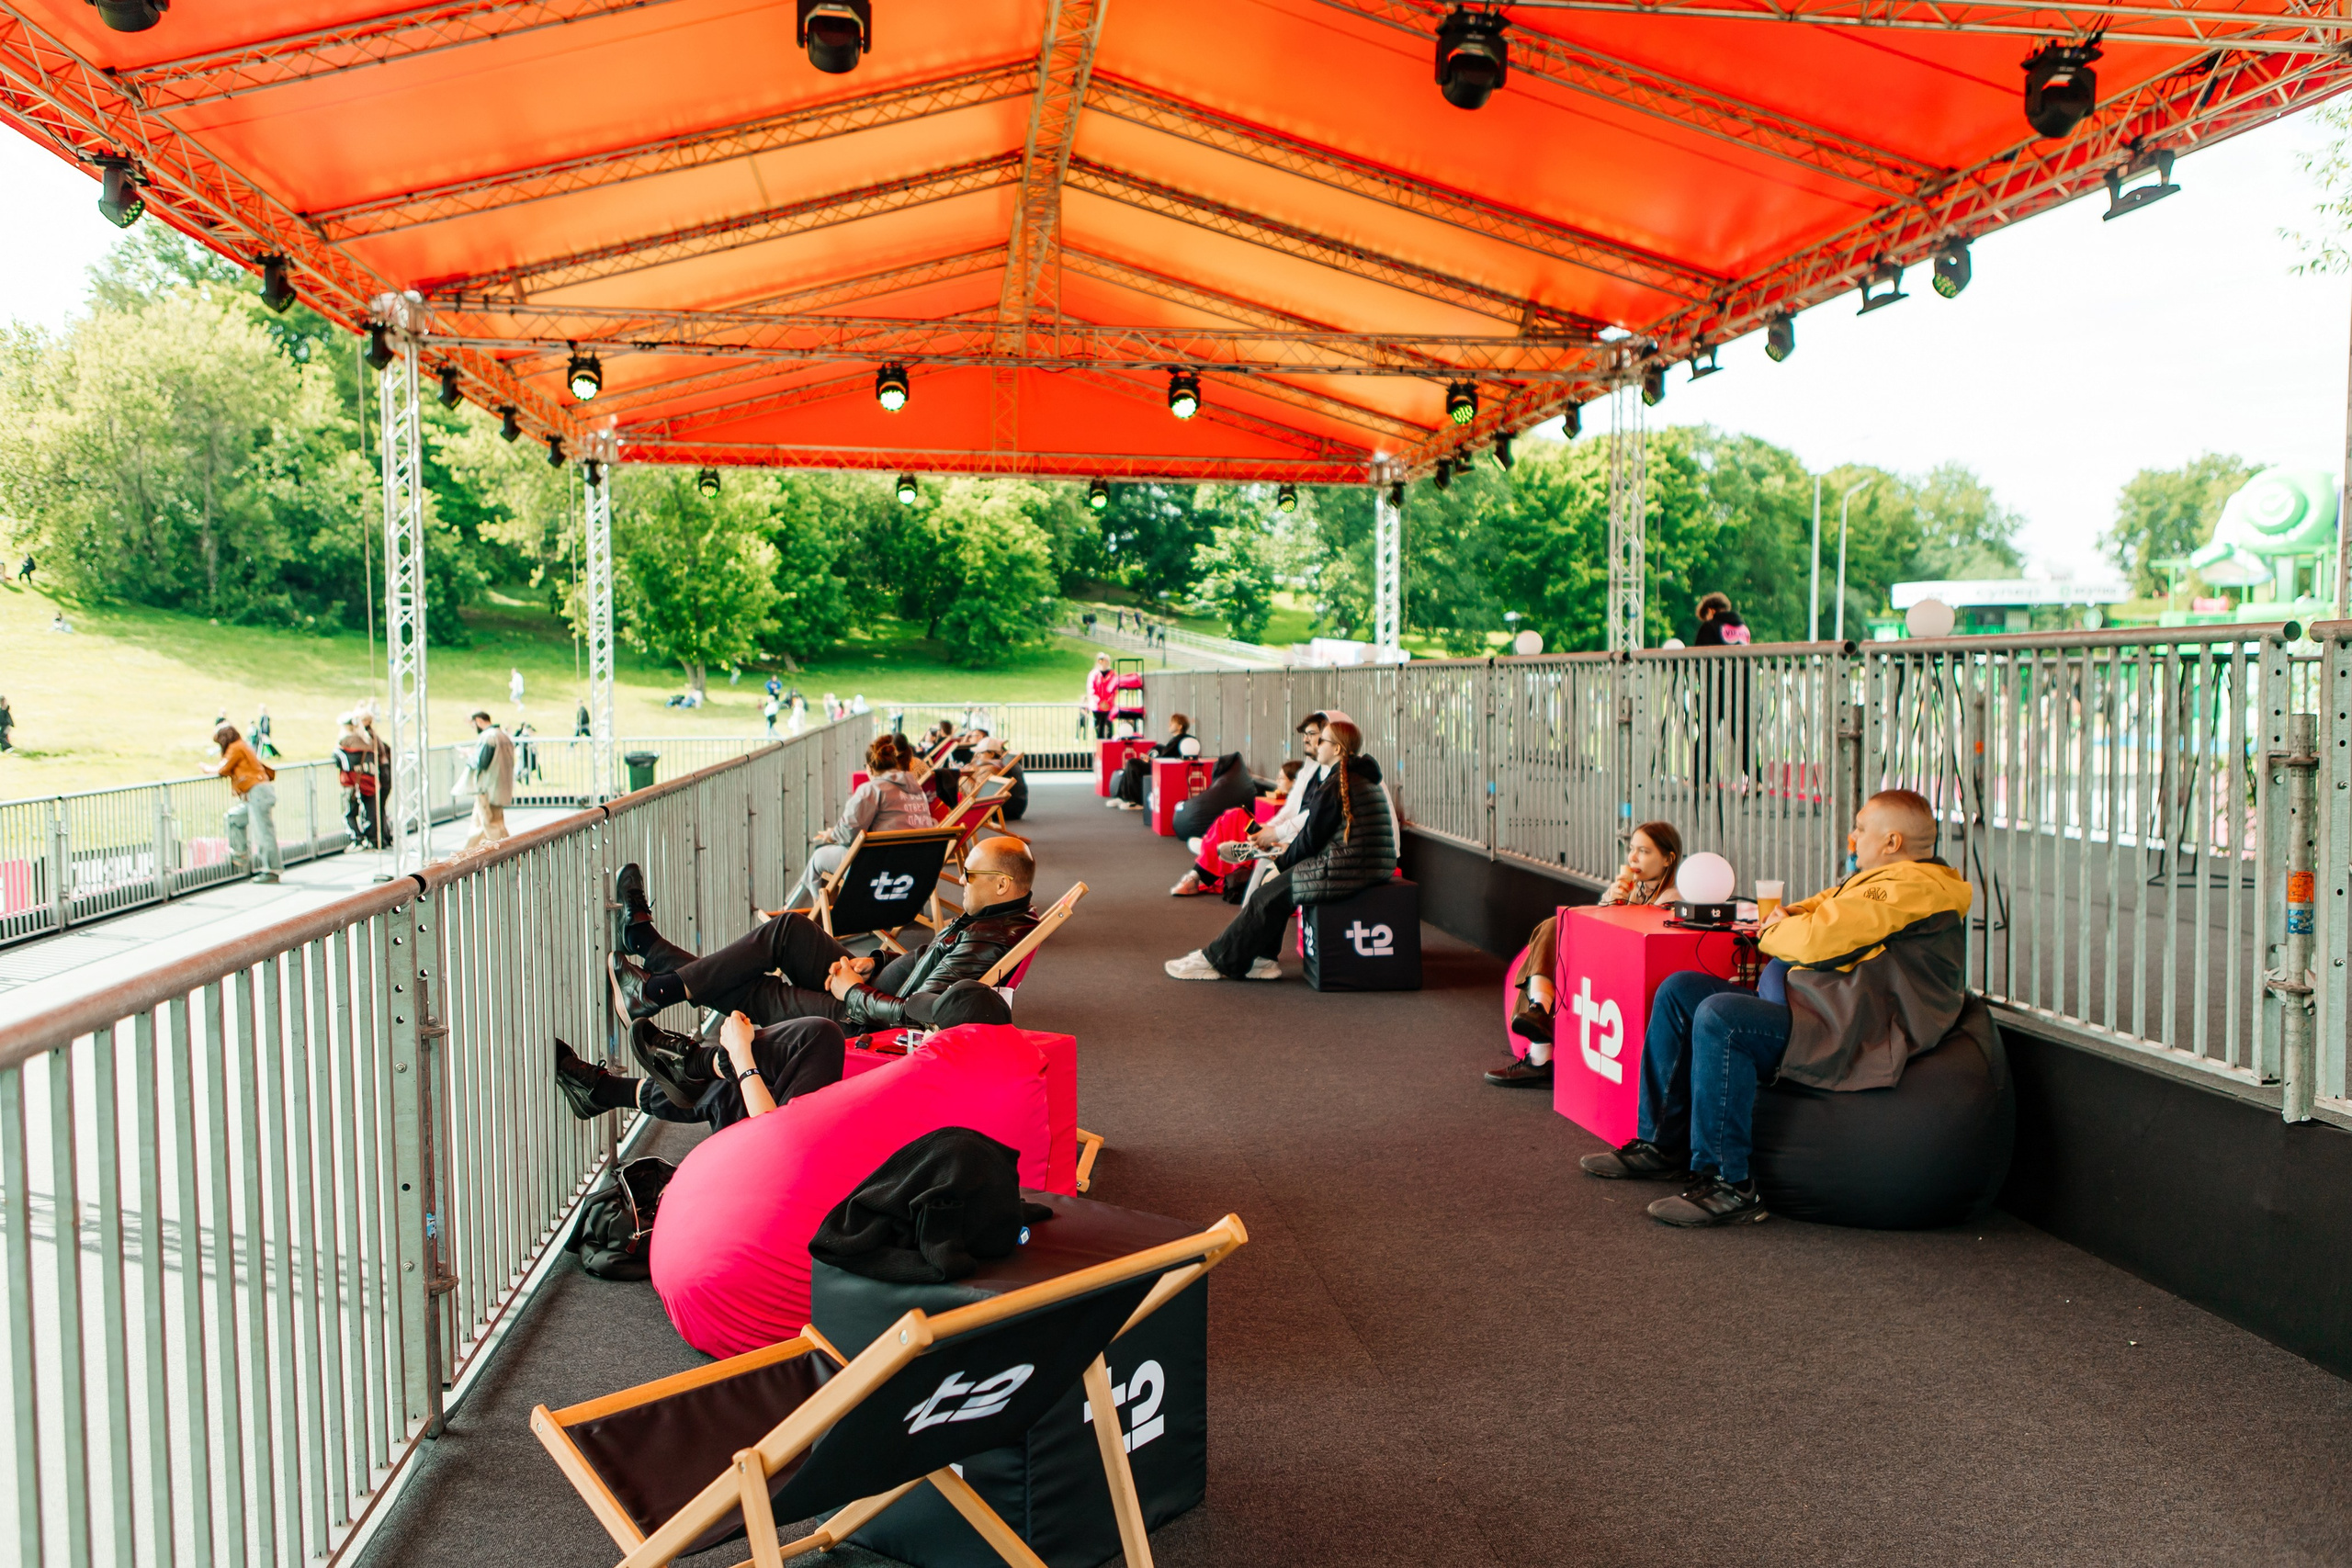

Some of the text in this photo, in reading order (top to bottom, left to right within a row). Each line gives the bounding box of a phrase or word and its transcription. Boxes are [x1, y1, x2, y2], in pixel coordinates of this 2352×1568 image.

[870, 871, 914, 900] t2
[1345, 920, 1394, 956] t2
[1573, 976, 1624, 1085] t2
[903, 1363, 1035, 1435] t2
